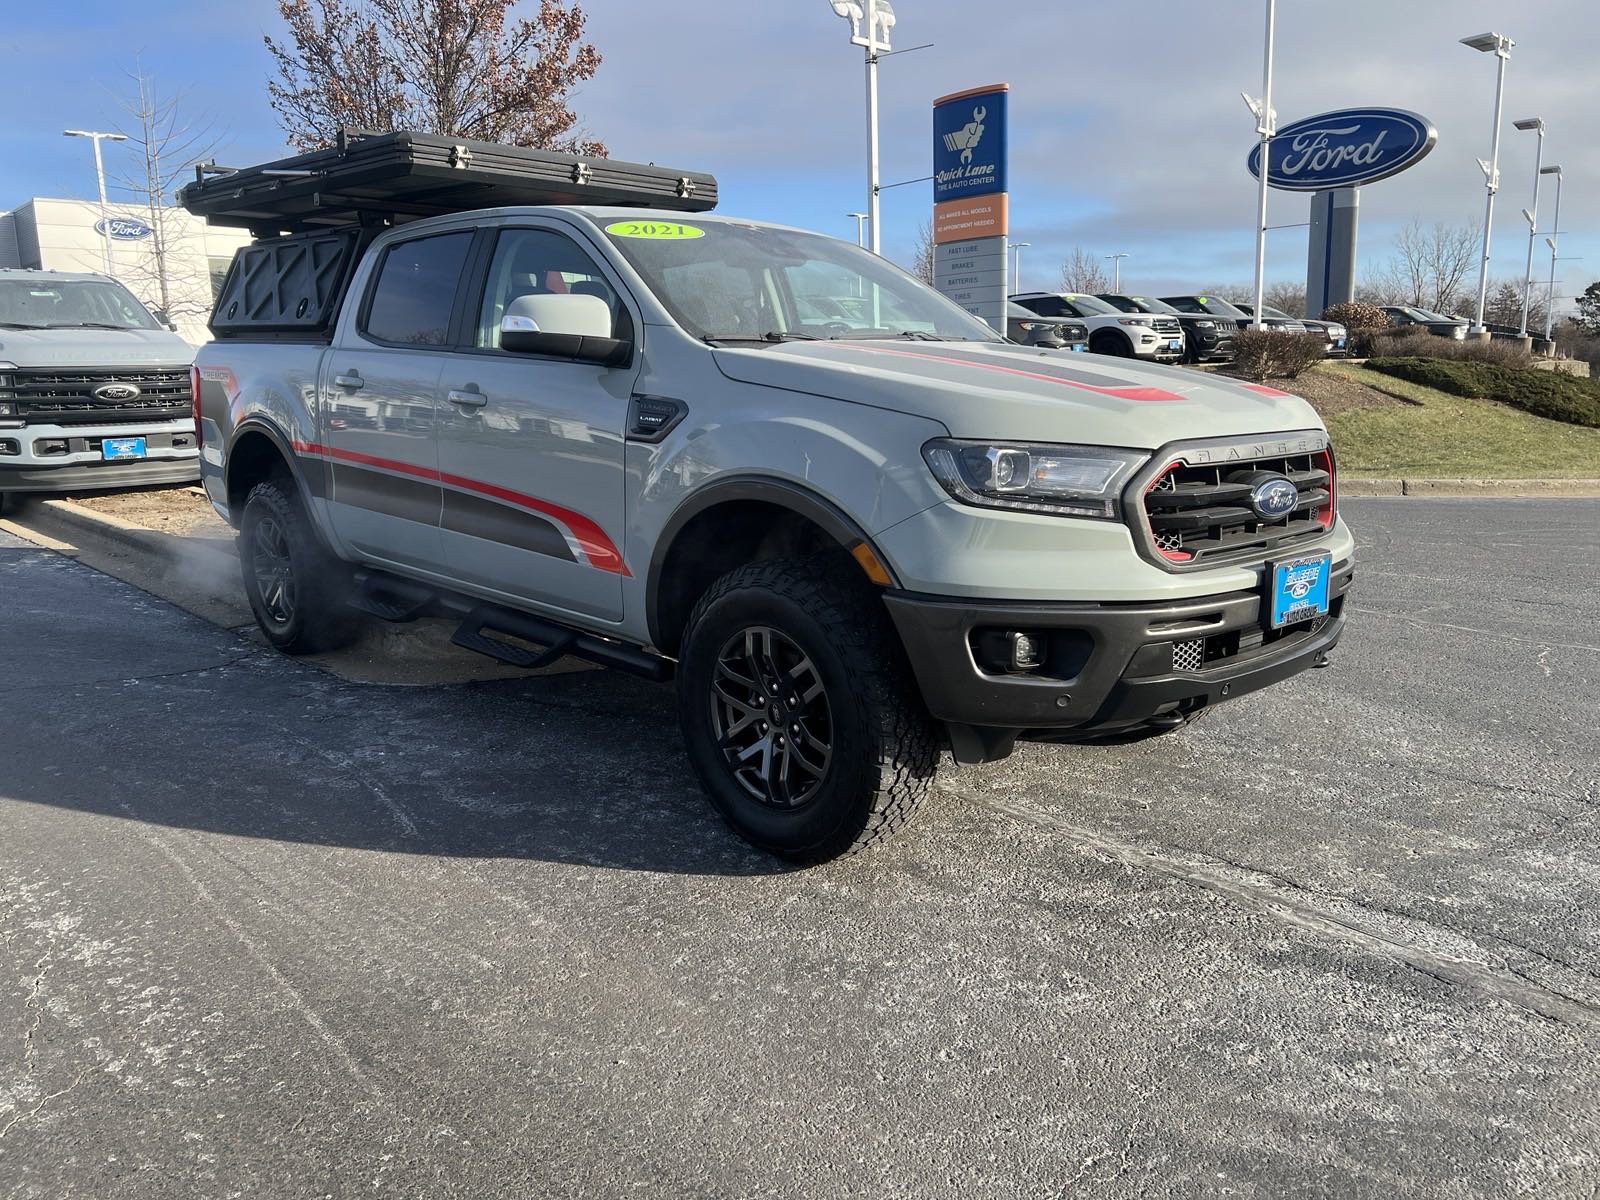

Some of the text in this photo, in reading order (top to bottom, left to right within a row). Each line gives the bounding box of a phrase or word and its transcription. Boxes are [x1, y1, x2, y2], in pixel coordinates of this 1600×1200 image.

[1281, 124, 1388, 175] Ford
[938, 165, 995, 183] Quick Lane
[953, 180, 968, 188] AUTO
[969, 176, 995, 185] CENTER
[970, 207, 992, 215] MODELS
[110, 221, 141, 235] Ford
[974, 219, 995, 227] NEEDED
[627, 224, 689, 236] 2021
[963, 245, 979, 253] LUBE
[951, 262, 974, 270] BRAKES
[948, 277, 979, 285] BATTERIES
[105, 388, 128, 398] Ford
[1197, 438, 1324, 462] RANGER
[1269, 487, 1293, 509] Ford
[1294, 584, 1307, 596] Ford
